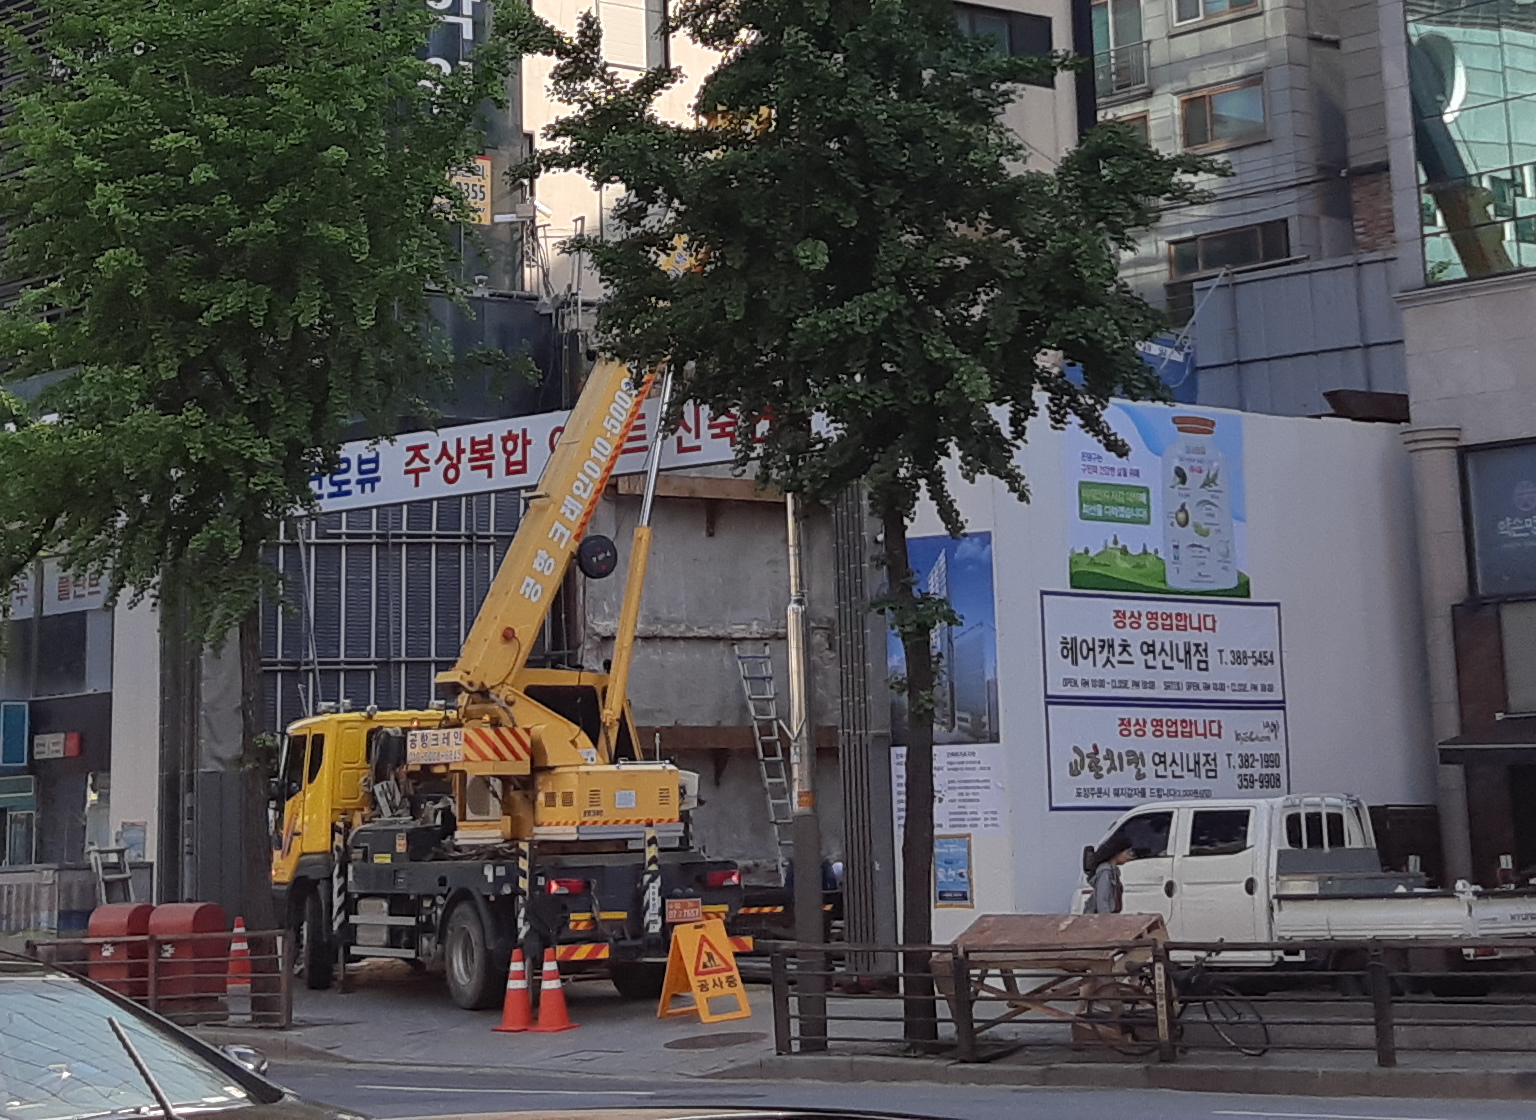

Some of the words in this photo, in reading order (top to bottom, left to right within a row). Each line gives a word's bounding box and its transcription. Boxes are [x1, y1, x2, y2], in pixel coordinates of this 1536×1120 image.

[403, 427, 533, 488] 주상복합
[1113, 609, 1143, 630] 정상
[1146, 610, 1219, 633] 영업합니다
[1140, 638, 1210, 672] 연신내점
[1117, 717, 1148, 738] 정상
[1150, 718, 1223, 739] 영업합니다
[1152, 751, 1219, 781] 연신내점
[697, 974, 738, 993] 공사중
